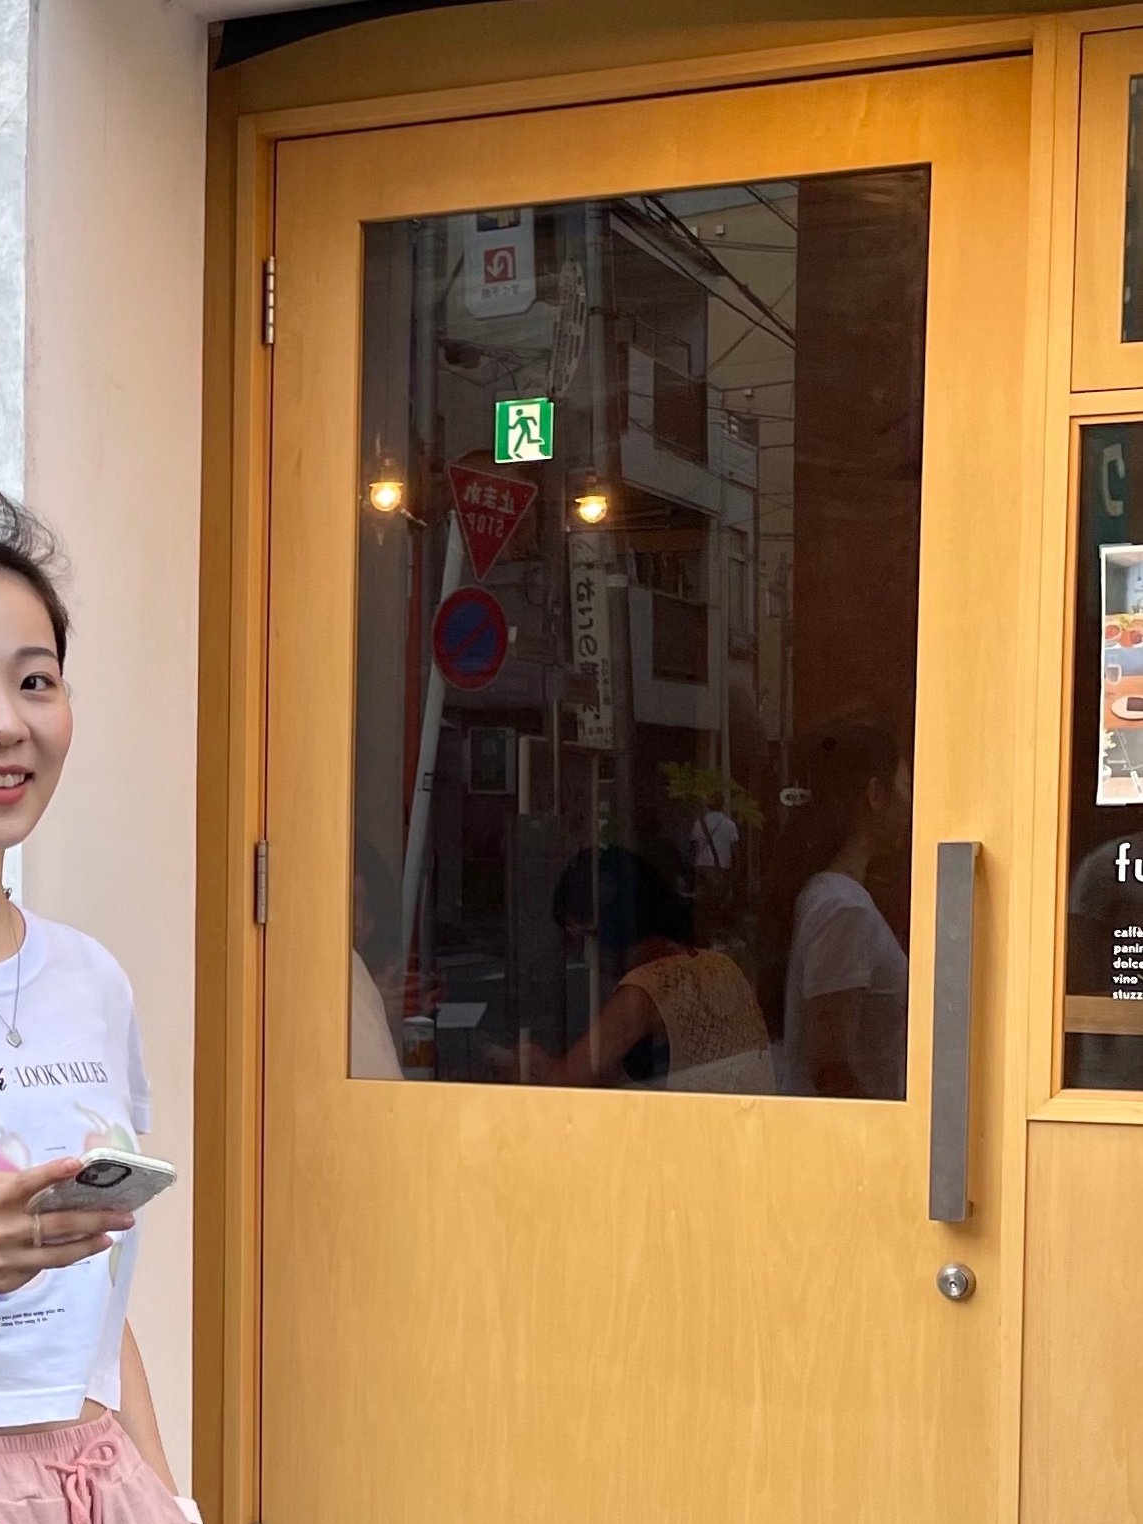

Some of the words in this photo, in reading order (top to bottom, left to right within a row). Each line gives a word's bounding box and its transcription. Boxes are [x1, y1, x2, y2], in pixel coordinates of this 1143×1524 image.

[1113, 974, 1138, 984] vino
[15, 1063, 62, 1088] LOOK
[55, 1061, 109, 1084] VALUES
